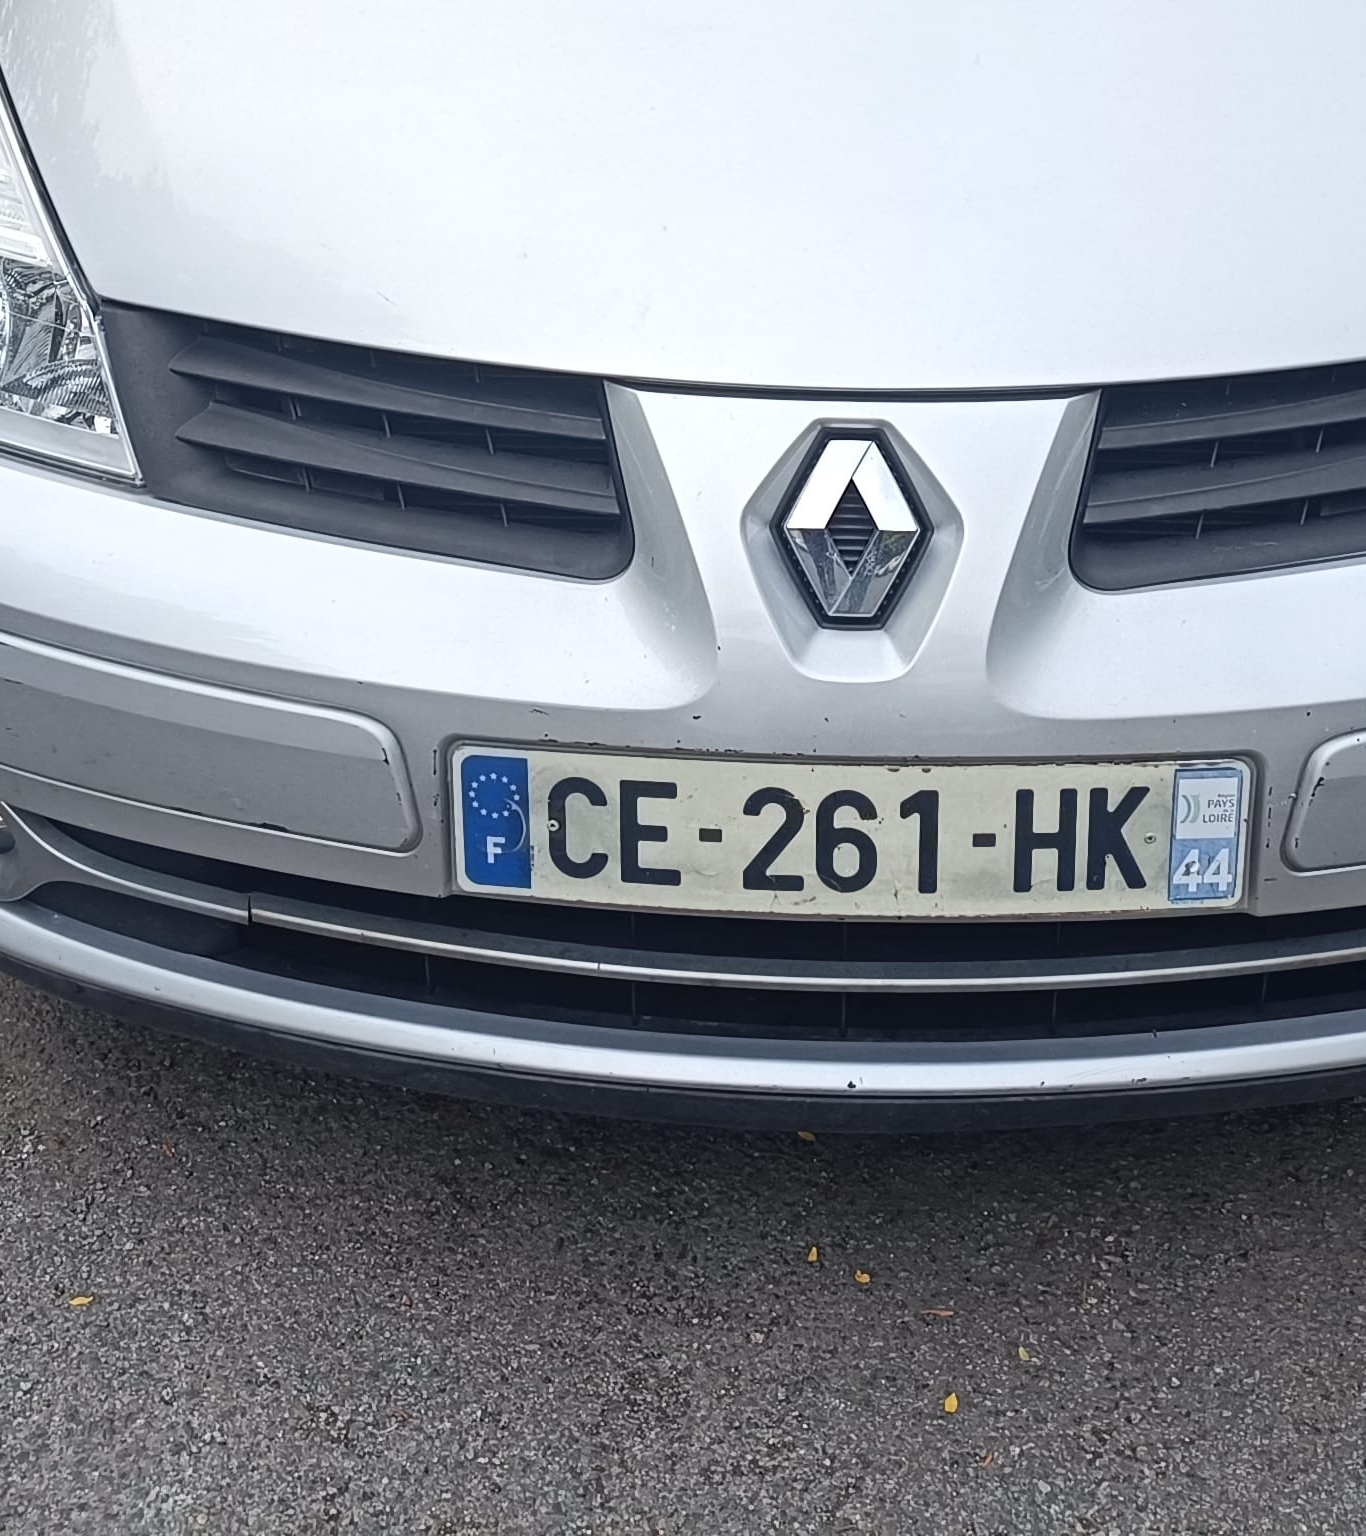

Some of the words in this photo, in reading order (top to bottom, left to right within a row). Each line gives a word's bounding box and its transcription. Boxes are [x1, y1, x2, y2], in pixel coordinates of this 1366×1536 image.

[1207, 798, 1235, 808] PAYS
[1202, 813, 1234, 824] LOIRE
[547, 776, 1151, 893] CE-261-HK
[486, 836, 506, 864] F
[1172, 847, 1233, 893] 44
